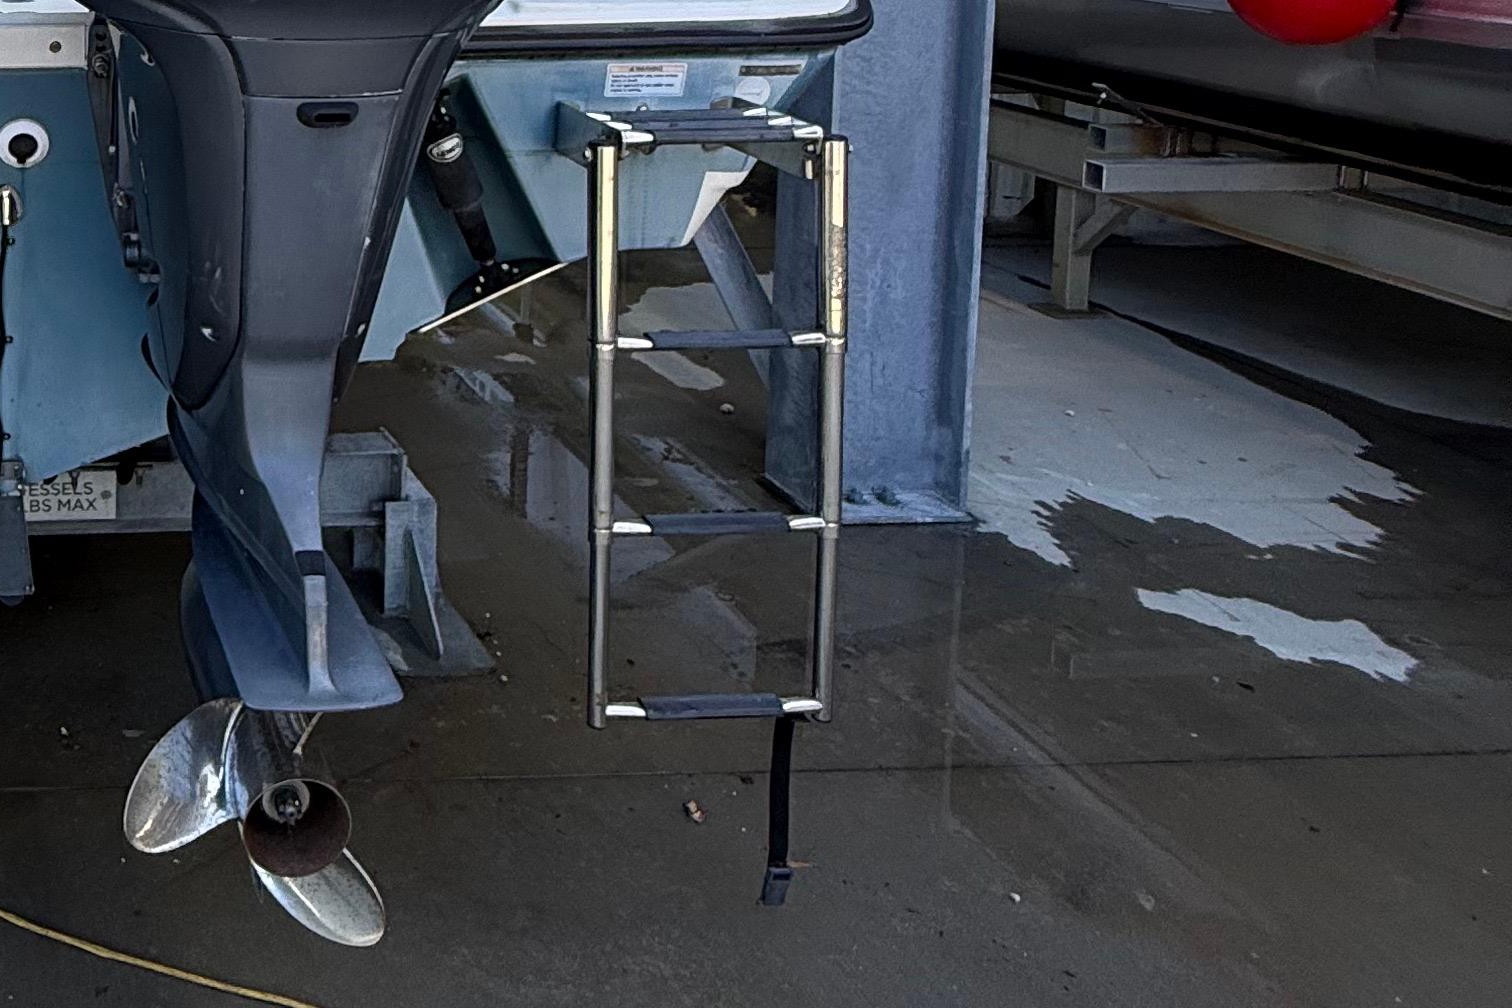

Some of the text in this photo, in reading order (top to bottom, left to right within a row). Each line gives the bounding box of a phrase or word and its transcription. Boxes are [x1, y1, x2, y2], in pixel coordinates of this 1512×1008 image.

[25, 481, 94, 497] ESSELS
[24, 498, 52, 513] BS
[57, 497, 97, 512] MAX
